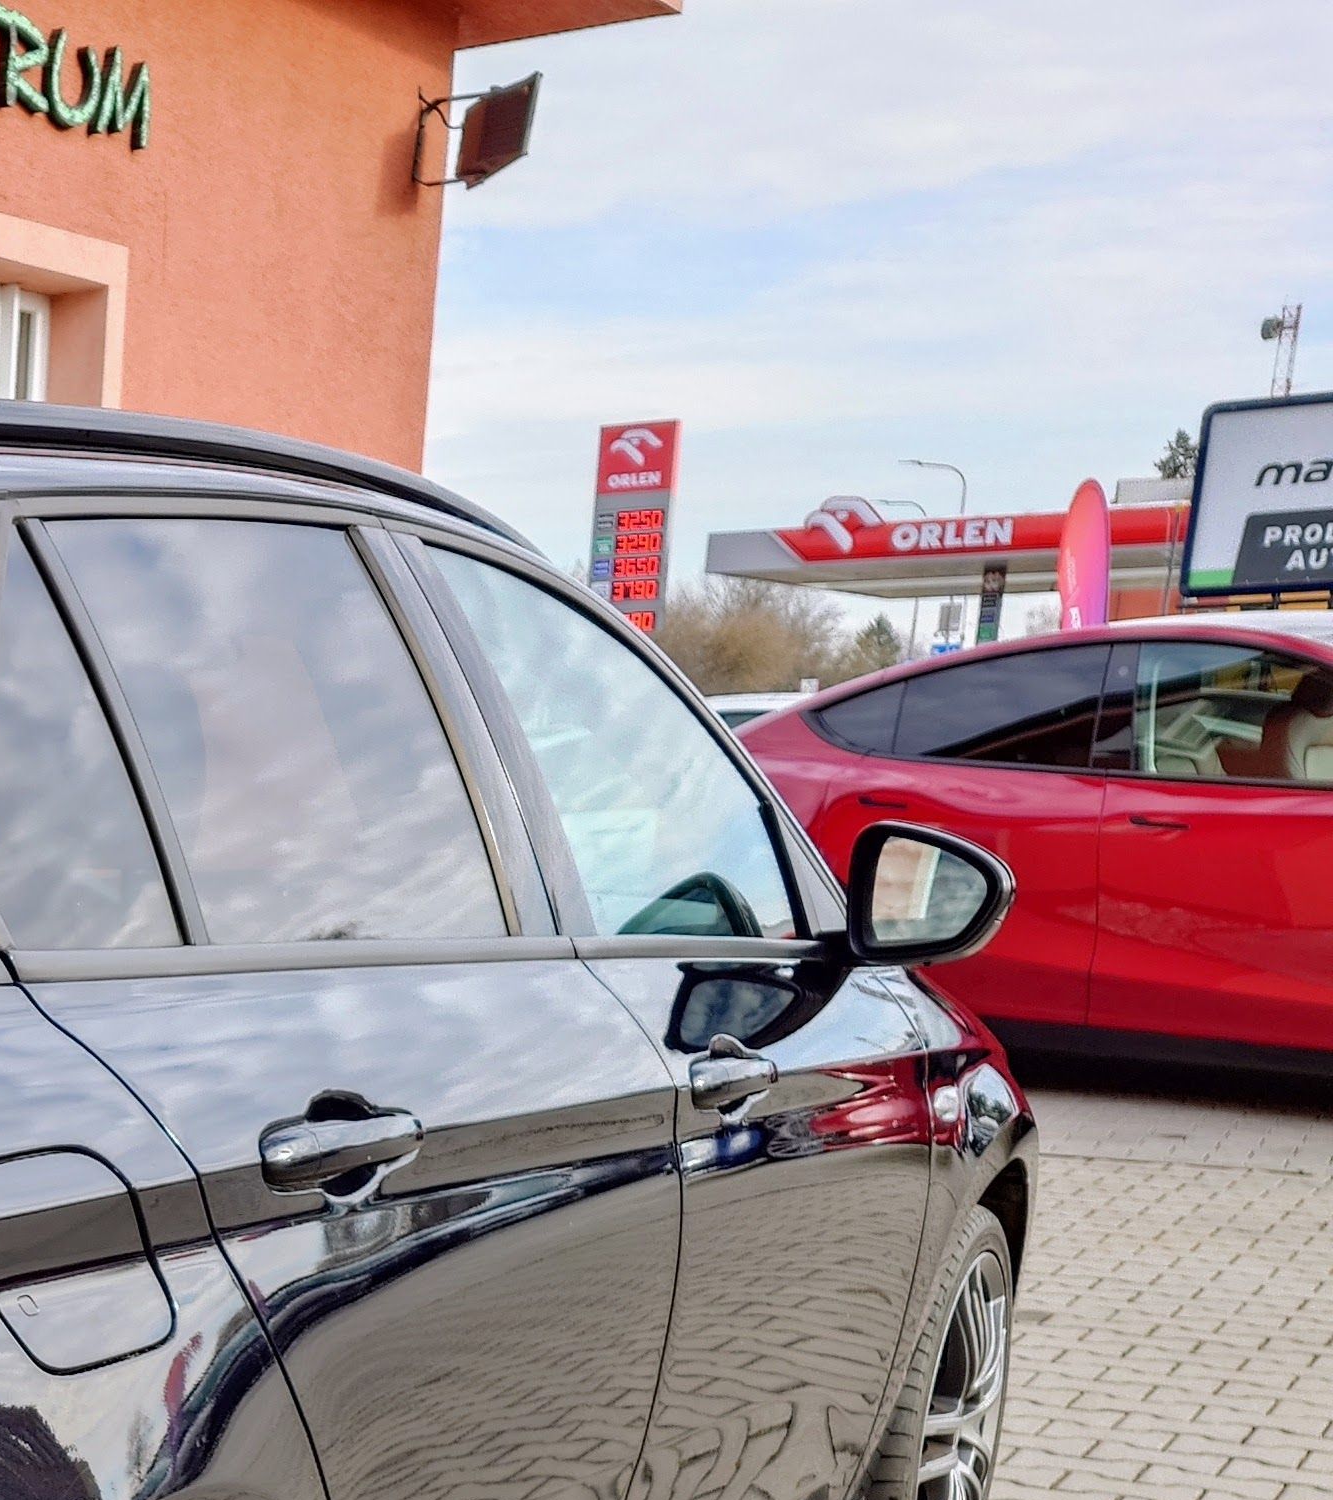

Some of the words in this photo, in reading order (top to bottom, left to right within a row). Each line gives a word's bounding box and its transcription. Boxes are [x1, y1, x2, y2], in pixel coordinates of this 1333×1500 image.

[607, 472, 662, 488] ORLEN
[891, 516, 1013, 551] ORLEN
[1285, 548, 1333, 571] AU
